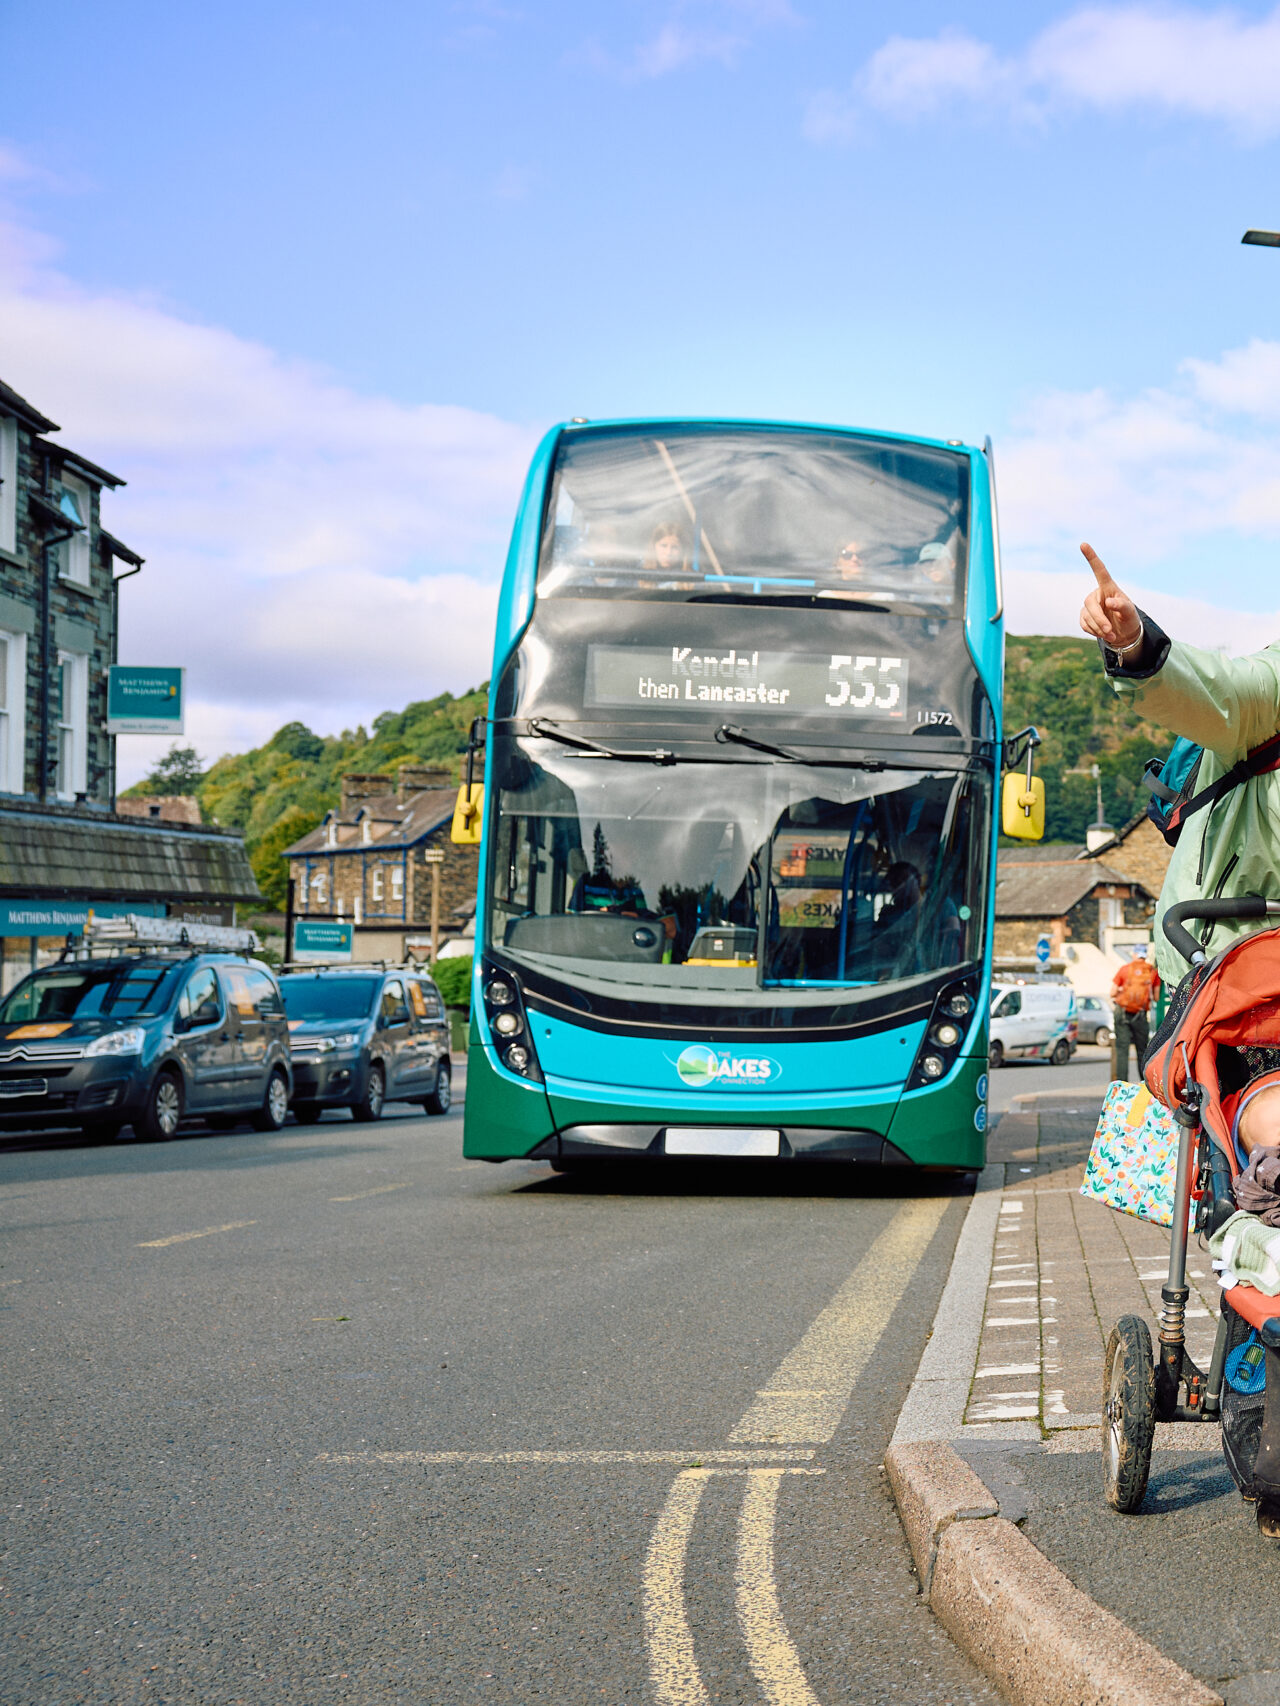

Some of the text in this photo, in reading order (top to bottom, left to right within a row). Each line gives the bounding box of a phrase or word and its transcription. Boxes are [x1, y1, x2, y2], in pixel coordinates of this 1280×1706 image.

[672, 647, 759, 679] Kendal
[638, 677, 790, 705] then Lancaster
[825, 654, 901, 709] 555
[916, 710, 954, 726] 11572
[8, 910, 88, 925] MATTHEWS BENJAMIN
[707, 1054, 771, 1078] LAKES
